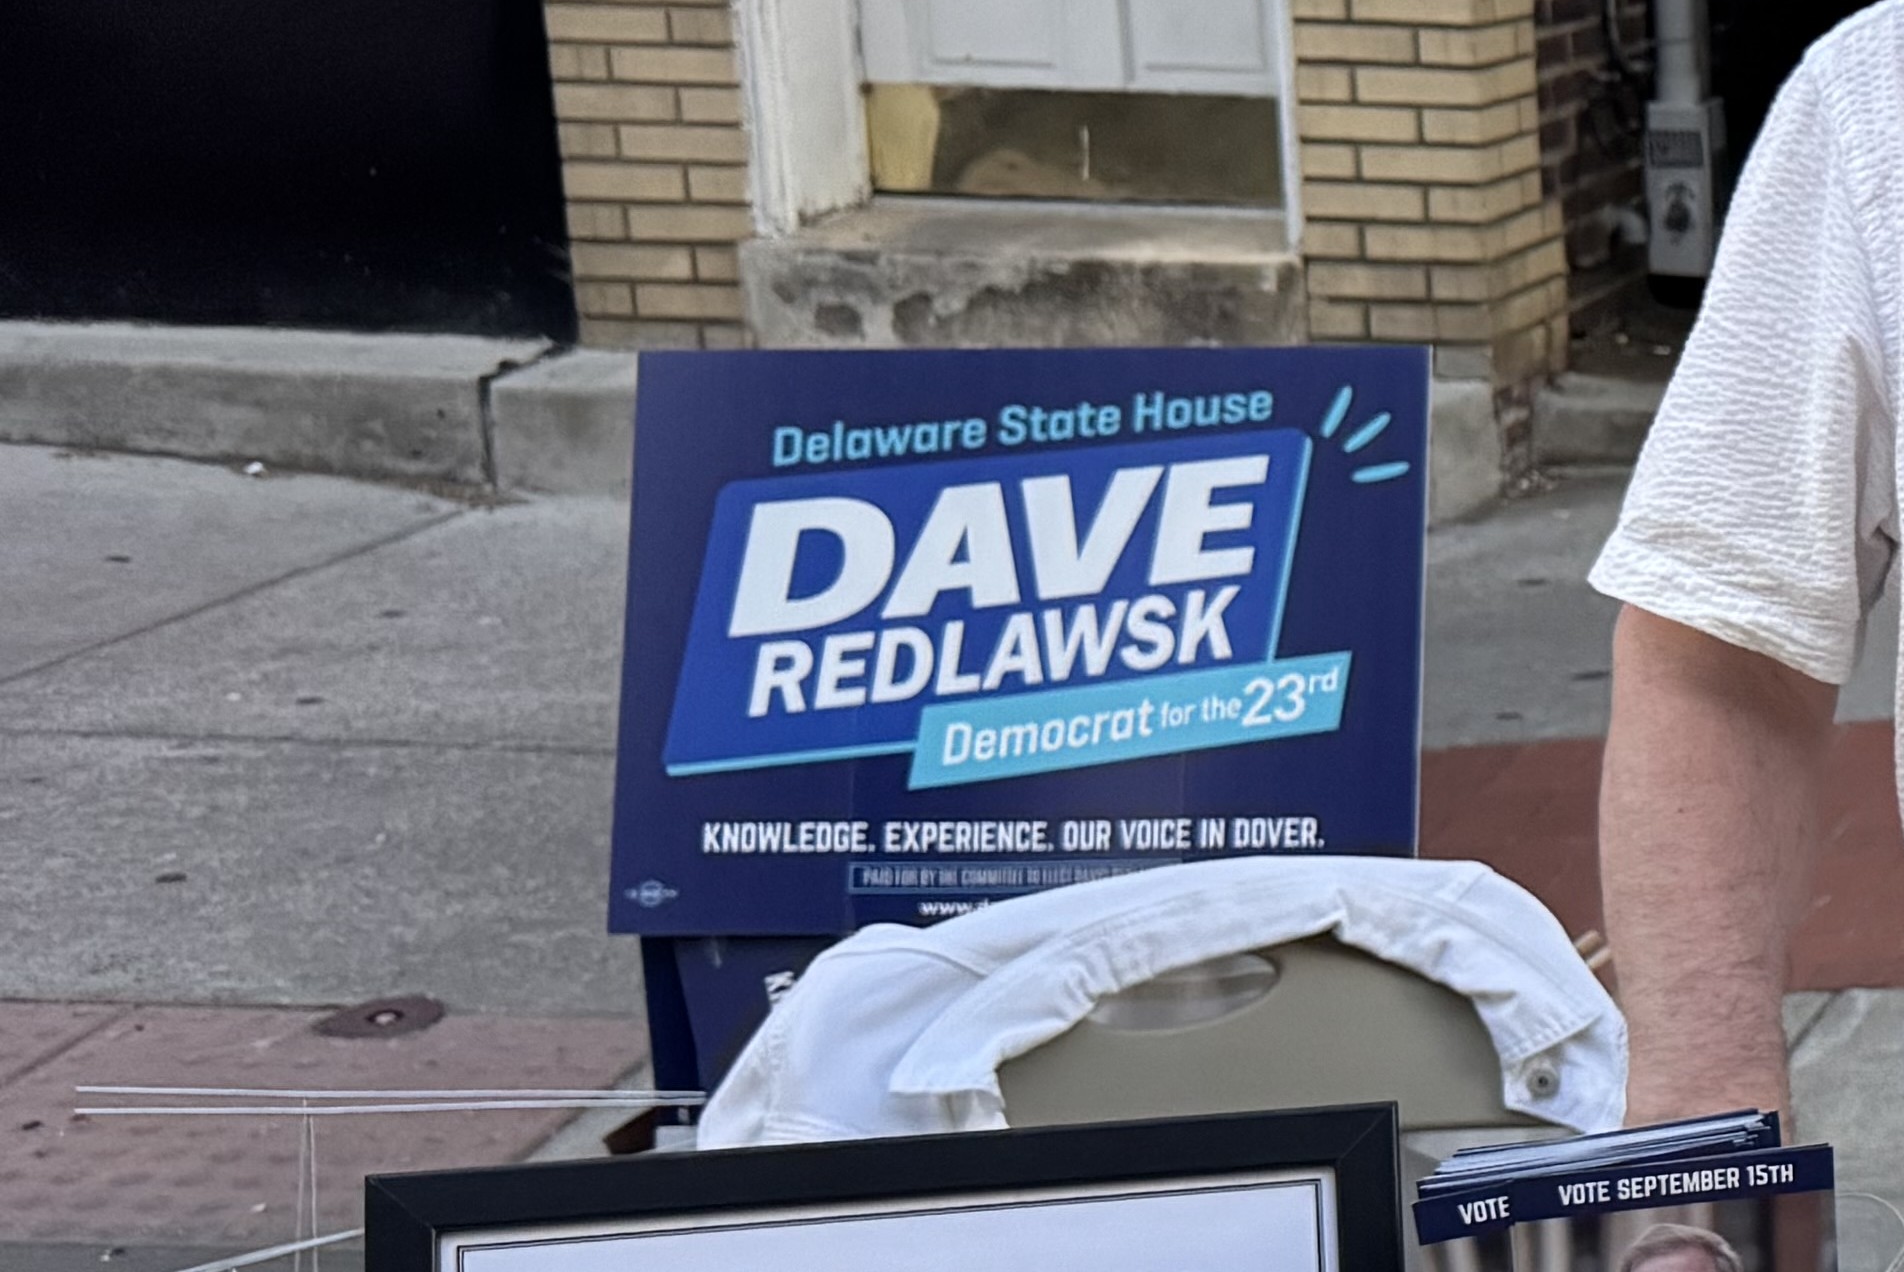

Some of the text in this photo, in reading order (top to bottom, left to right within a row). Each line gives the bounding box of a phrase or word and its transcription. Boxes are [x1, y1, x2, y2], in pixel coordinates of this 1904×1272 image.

[772, 390, 1273, 467] Delaware State House
[726, 454, 1271, 637] DAVE
[747, 586, 1242, 718] REDLAWSK
[941, 667, 1339, 767] Democrat for the 23rd
[703, 819, 1324, 854] KNOWLEDGE. EXPERIENCE. OUR VOICE IN DOVER.
[1458, 1196, 1510, 1225] VOTE
[1558, 1164, 1794, 1206] VOTE SEPTEMBER 15TH
